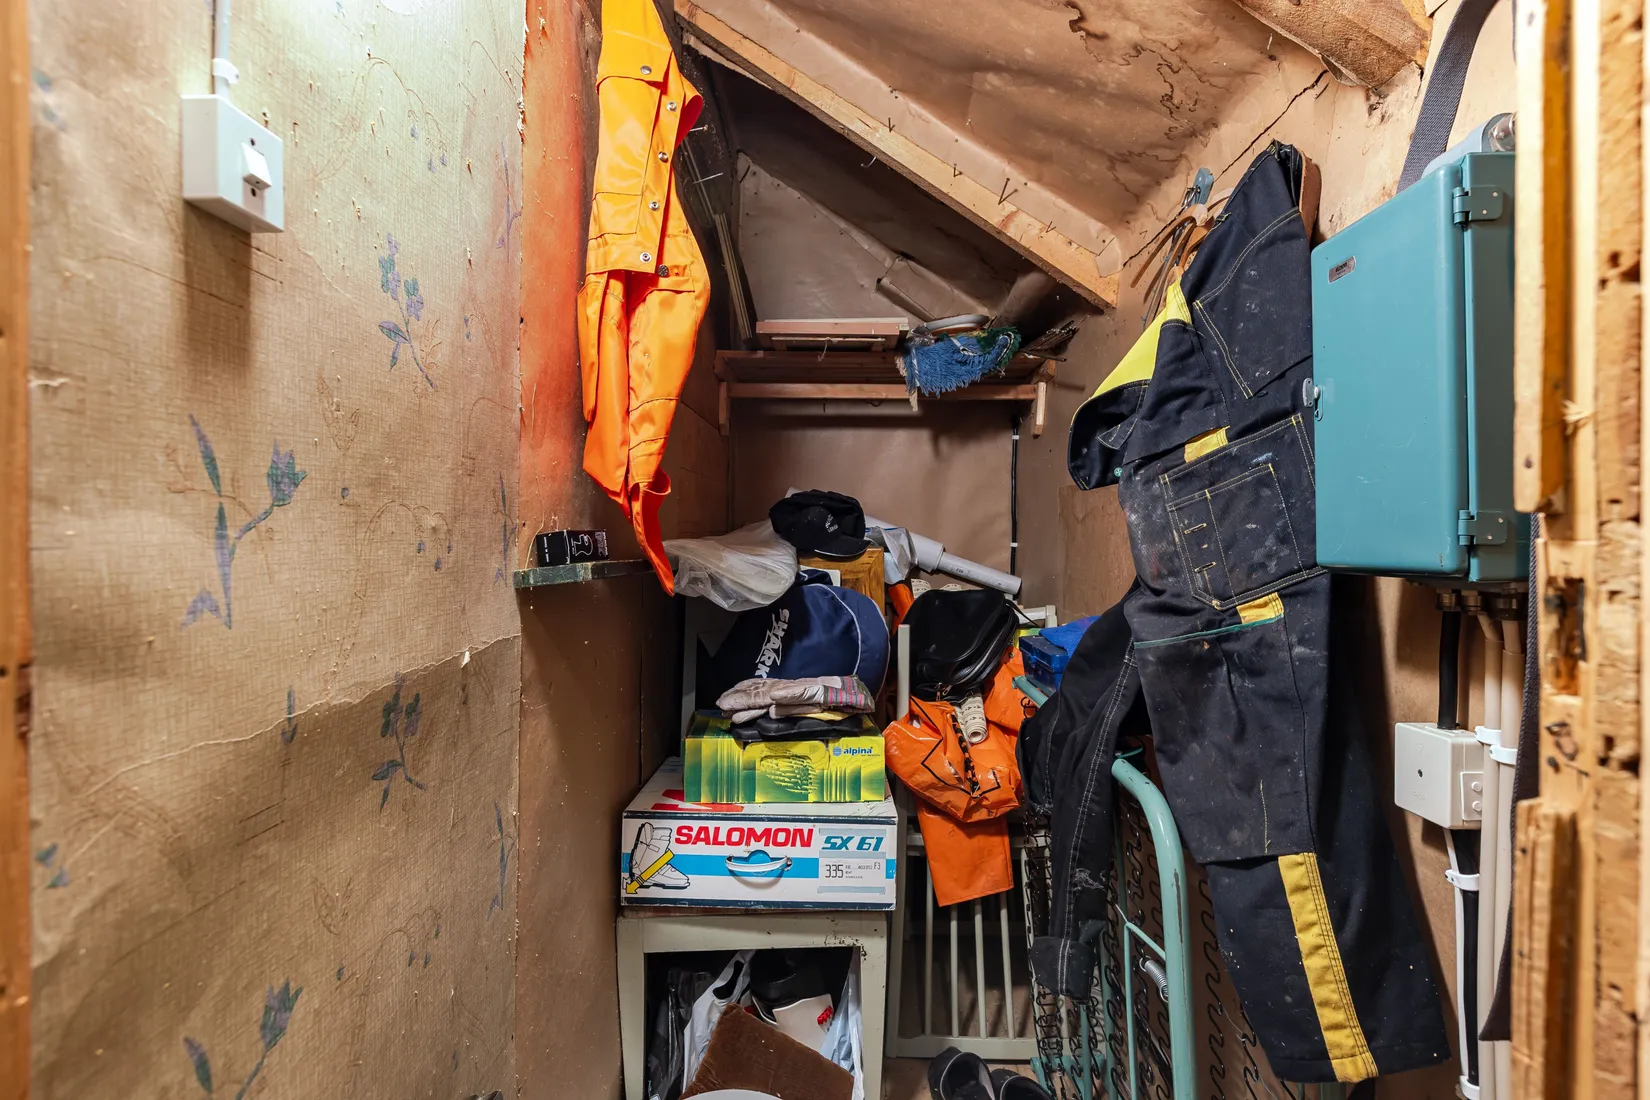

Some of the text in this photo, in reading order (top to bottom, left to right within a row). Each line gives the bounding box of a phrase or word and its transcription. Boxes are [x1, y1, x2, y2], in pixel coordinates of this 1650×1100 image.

[754, 608, 790, 679] SHARK
[843, 746, 872, 756] alpina
[674, 825, 814, 848] SALOMON
[821, 835, 884, 852] SX 61
[824, 864, 844, 879] 335
